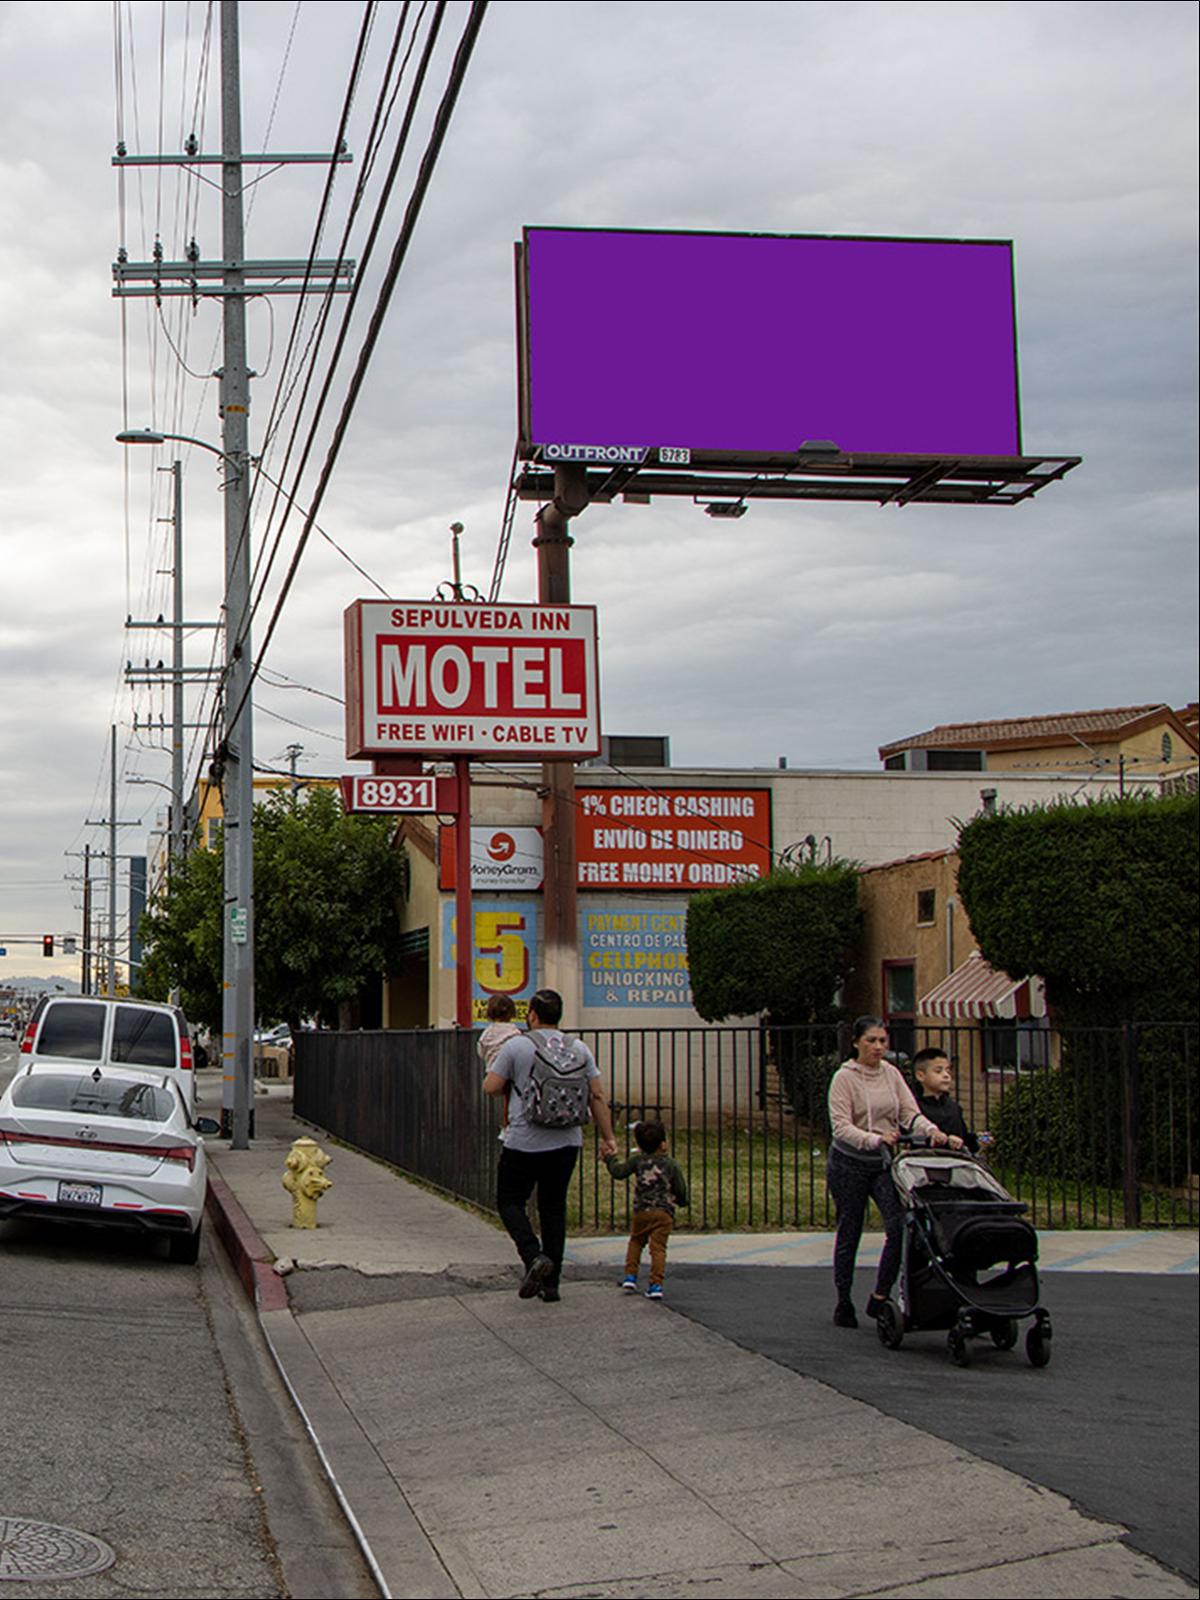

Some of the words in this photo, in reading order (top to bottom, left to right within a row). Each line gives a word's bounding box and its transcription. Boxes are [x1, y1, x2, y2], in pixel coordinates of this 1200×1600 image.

[548, 444, 643, 461] OUTFRONT
[391, 609, 523, 630] SEPULVEDA
[532, 612, 570, 630] INN
[381, 644, 581, 710] MOTEL
[377, 723, 426, 740] FREE
[432, 724, 474, 741] WIFI
[492, 725, 555, 743] CABLE
[562, 726, 588, 743] TV
[362, 781, 428, 806] 8931
[580, 795, 606, 816] 1%
[610, 795, 671, 816] CHECK
[674, 796, 754, 817] CASHING
[651, 829, 674, 849] DE
[677, 830, 743, 850] DINERO
[578, 862, 619, 882] FREE
[623, 863, 685, 882] MONEY
[688, 863, 761, 884] ORDERS
[588, 914, 648, 931] PAYMENT
[590, 934, 641, 947] CENTRO
[645, 934, 661, 947] DE
[451, 912, 529, 995] 5
[592, 971, 685, 987] UNLOCKING
[606, 989, 619, 1003] &
